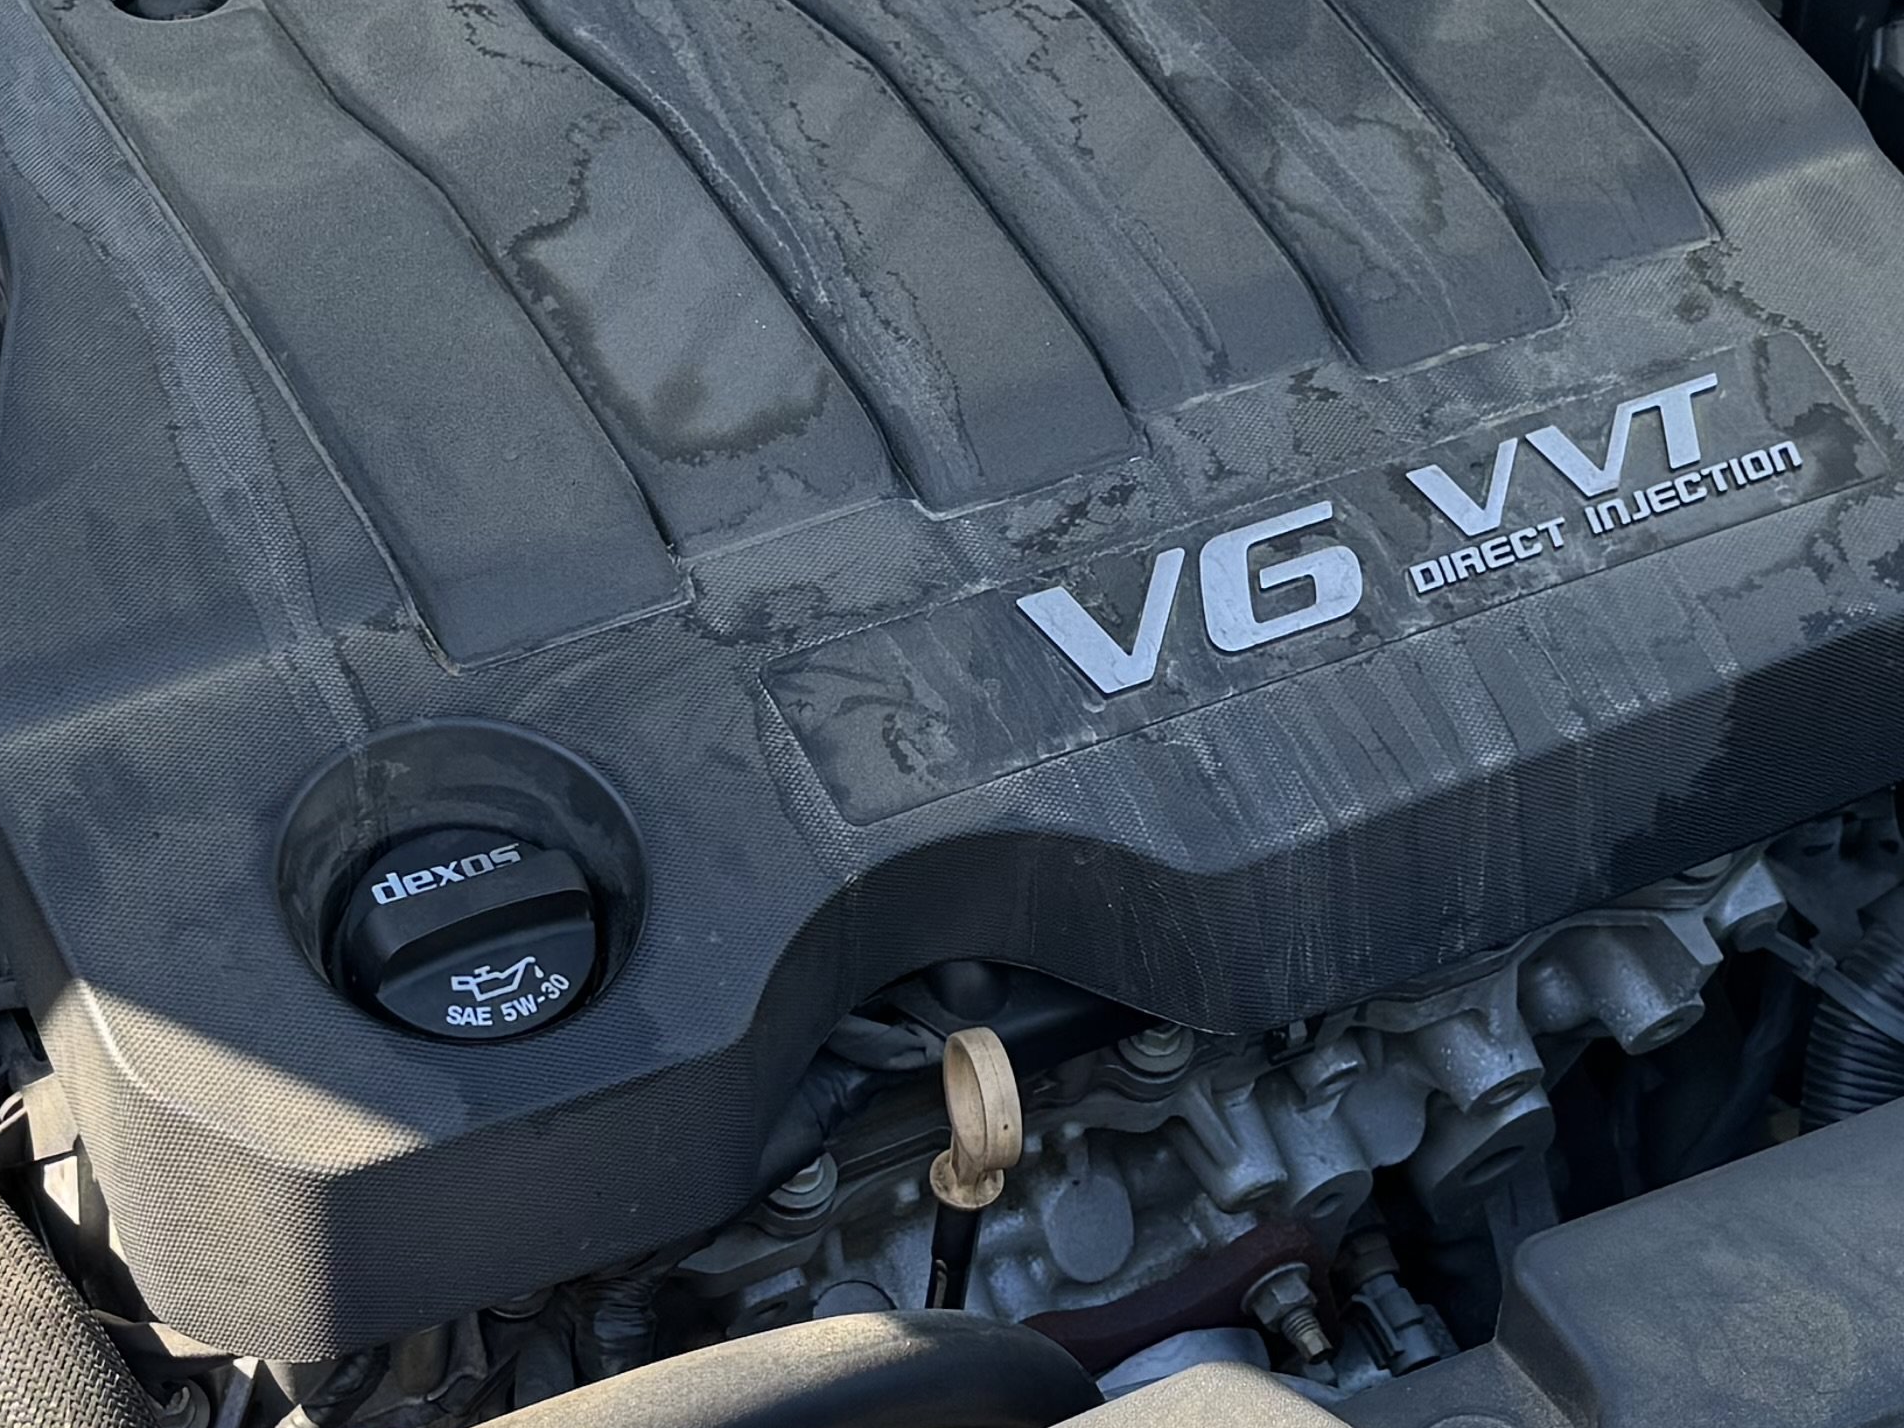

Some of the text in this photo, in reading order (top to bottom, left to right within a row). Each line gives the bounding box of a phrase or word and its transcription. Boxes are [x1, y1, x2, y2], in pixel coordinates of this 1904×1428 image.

[1406, 372, 1718, 538] VVT
[1408, 439, 1803, 596] DIRECT INJECTION
[1015, 500, 1365, 695] V6
[371, 842, 522, 906] dexos
[446, 973, 570, 1027] SAE 5W-30
